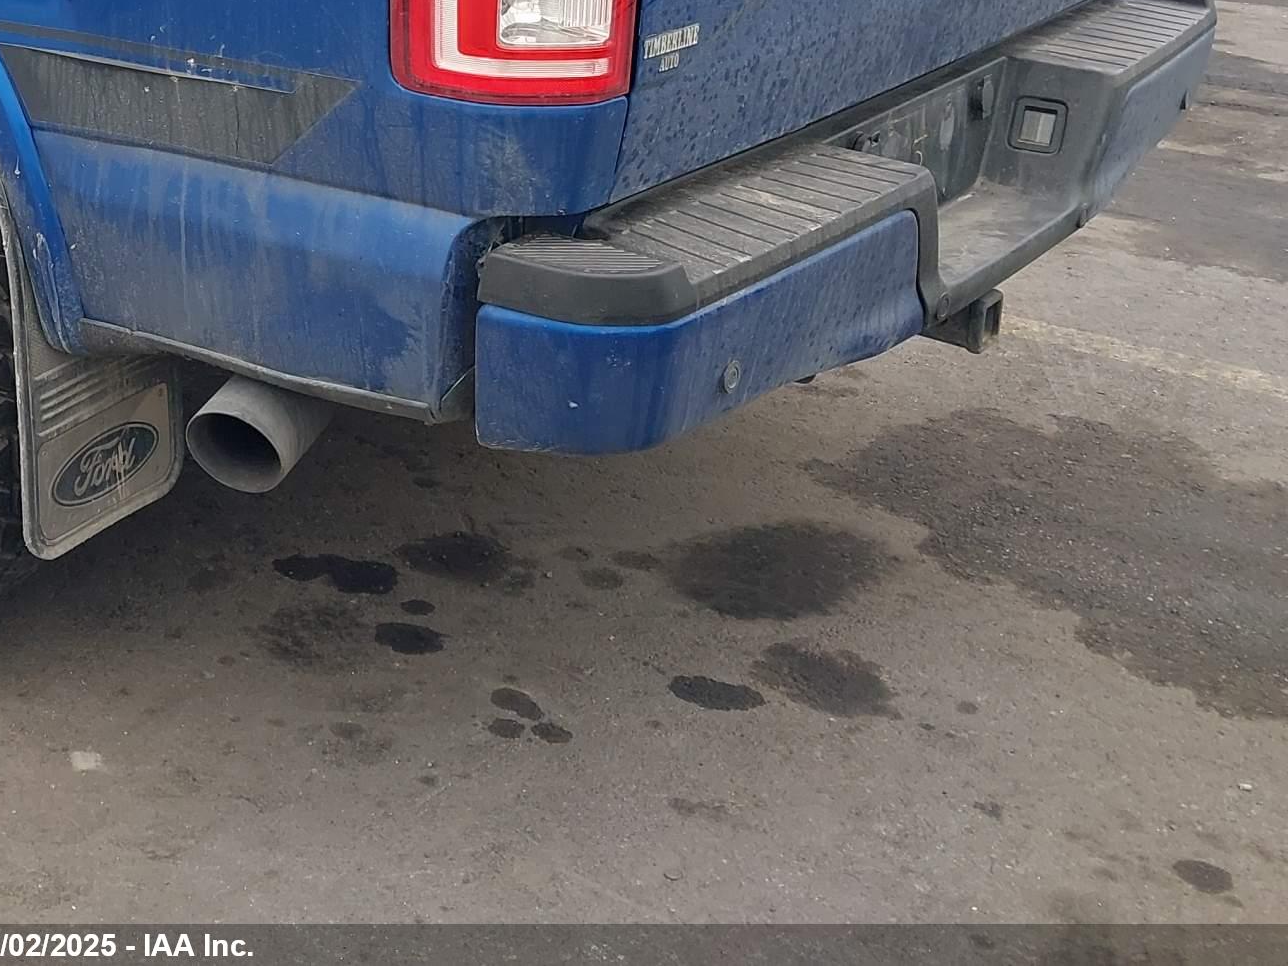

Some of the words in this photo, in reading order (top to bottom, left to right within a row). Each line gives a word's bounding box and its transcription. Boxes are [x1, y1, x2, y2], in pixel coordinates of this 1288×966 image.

[643, 22, 700, 60] TIMBERLINE
[658, 51, 680, 73] AUTO
[73, 436, 137, 497] Ford
